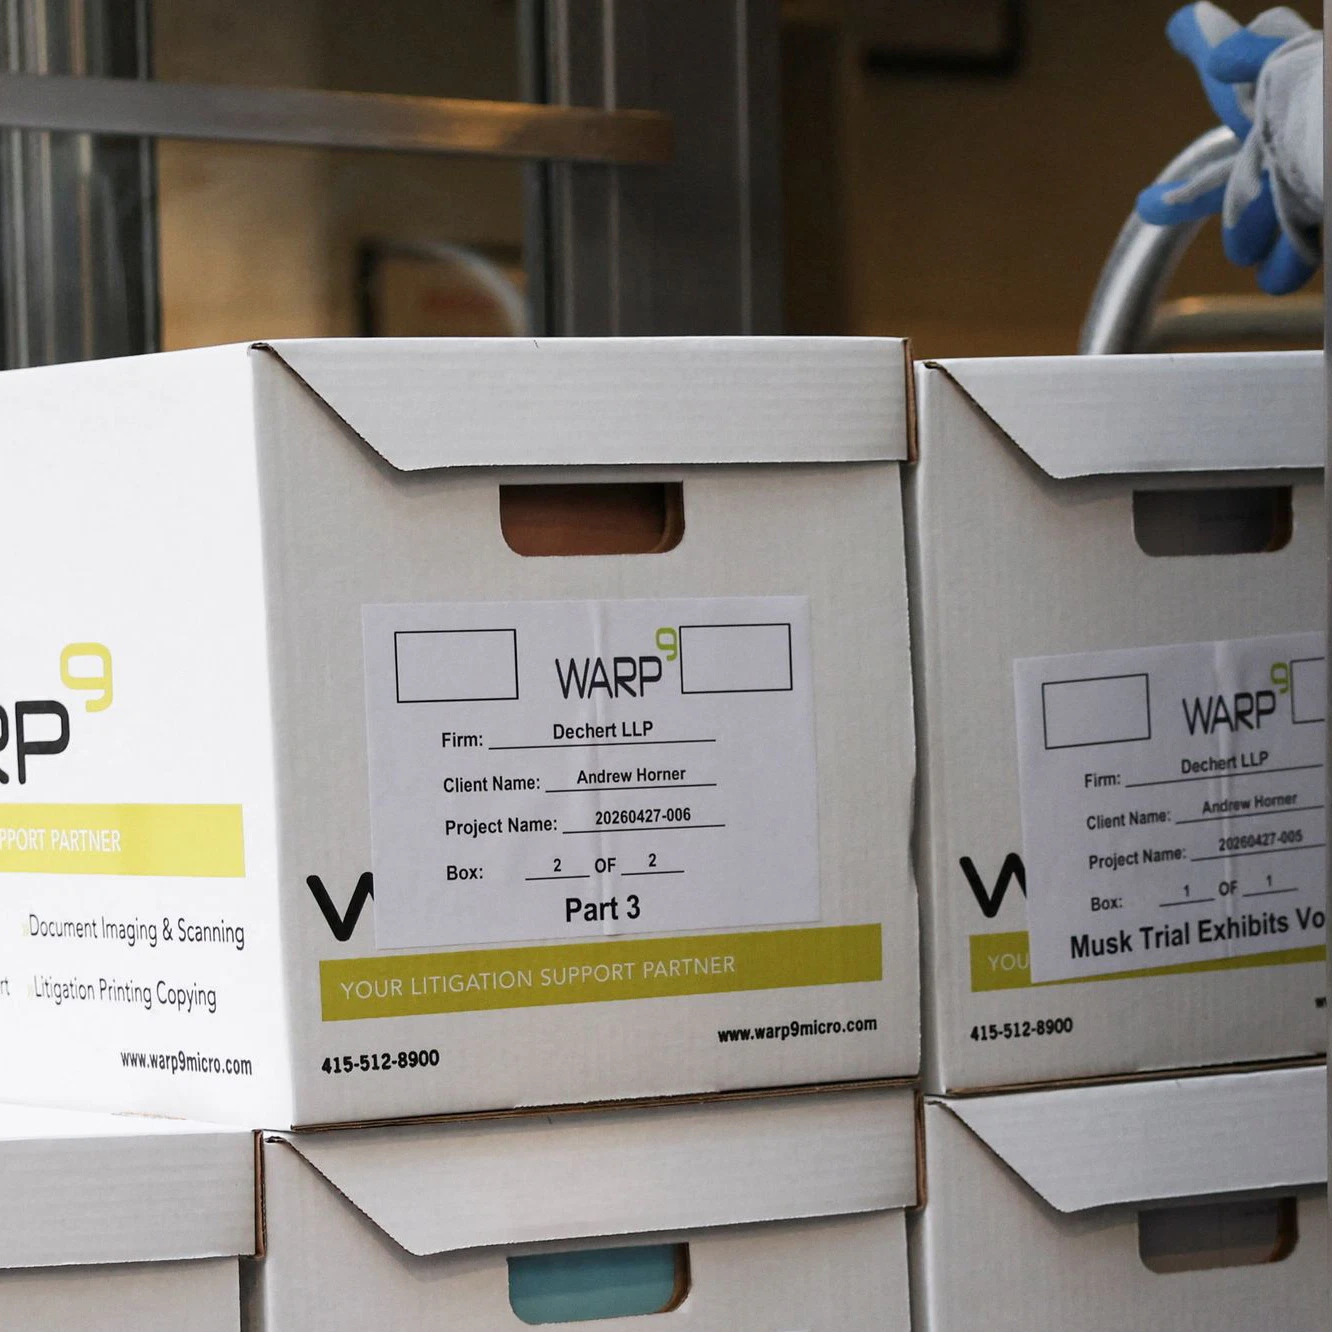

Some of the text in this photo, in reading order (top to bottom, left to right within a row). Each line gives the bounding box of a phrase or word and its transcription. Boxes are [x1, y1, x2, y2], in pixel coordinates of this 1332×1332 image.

[442, 721, 653, 748] Firm: Dechert LLP
[443, 768, 686, 793] Client Name: Andrew Horner
[1084, 750, 1269, 788] Firm: Dechert LLP
[445, 807, 691, 838] Project Name: 20260427-006
[1086, 794, 1298, 830] Client Name: Andrew Horner
[50, 829, 121, 852] PARTNER
[447, 853, 656, 881] Box: 2 OF 2
[1089, 851, 1139, 871] Project
[1143, 848, 1186, 863] Name:
[566, 894, 640, 922] Part 3
[1091, 897, 1123, 912] Box:
[1218, 880, 1238, 896] OF
[29, 914, 245, 951] Document Imaging & Scanning
[1070, 930, 1133, 959] Musk
[1139, 922, 1190, 950] Trial
[1198, 912, 1289, 943] Exhibits
[340, 955, 735, 1000] YOUR LITIGATION SUPPORT PARTNER
[34, 976, 216, 1014] Litigation Printing Copying
[717, 1019, 877, 1043] www.warp9micro.com
[970, 1017, 1073, 1041] 415-512-8900
[120, 1050, 252, 1075] www.warp9micro.com
[321, 1049, 440, 1074] 415-512-8900
